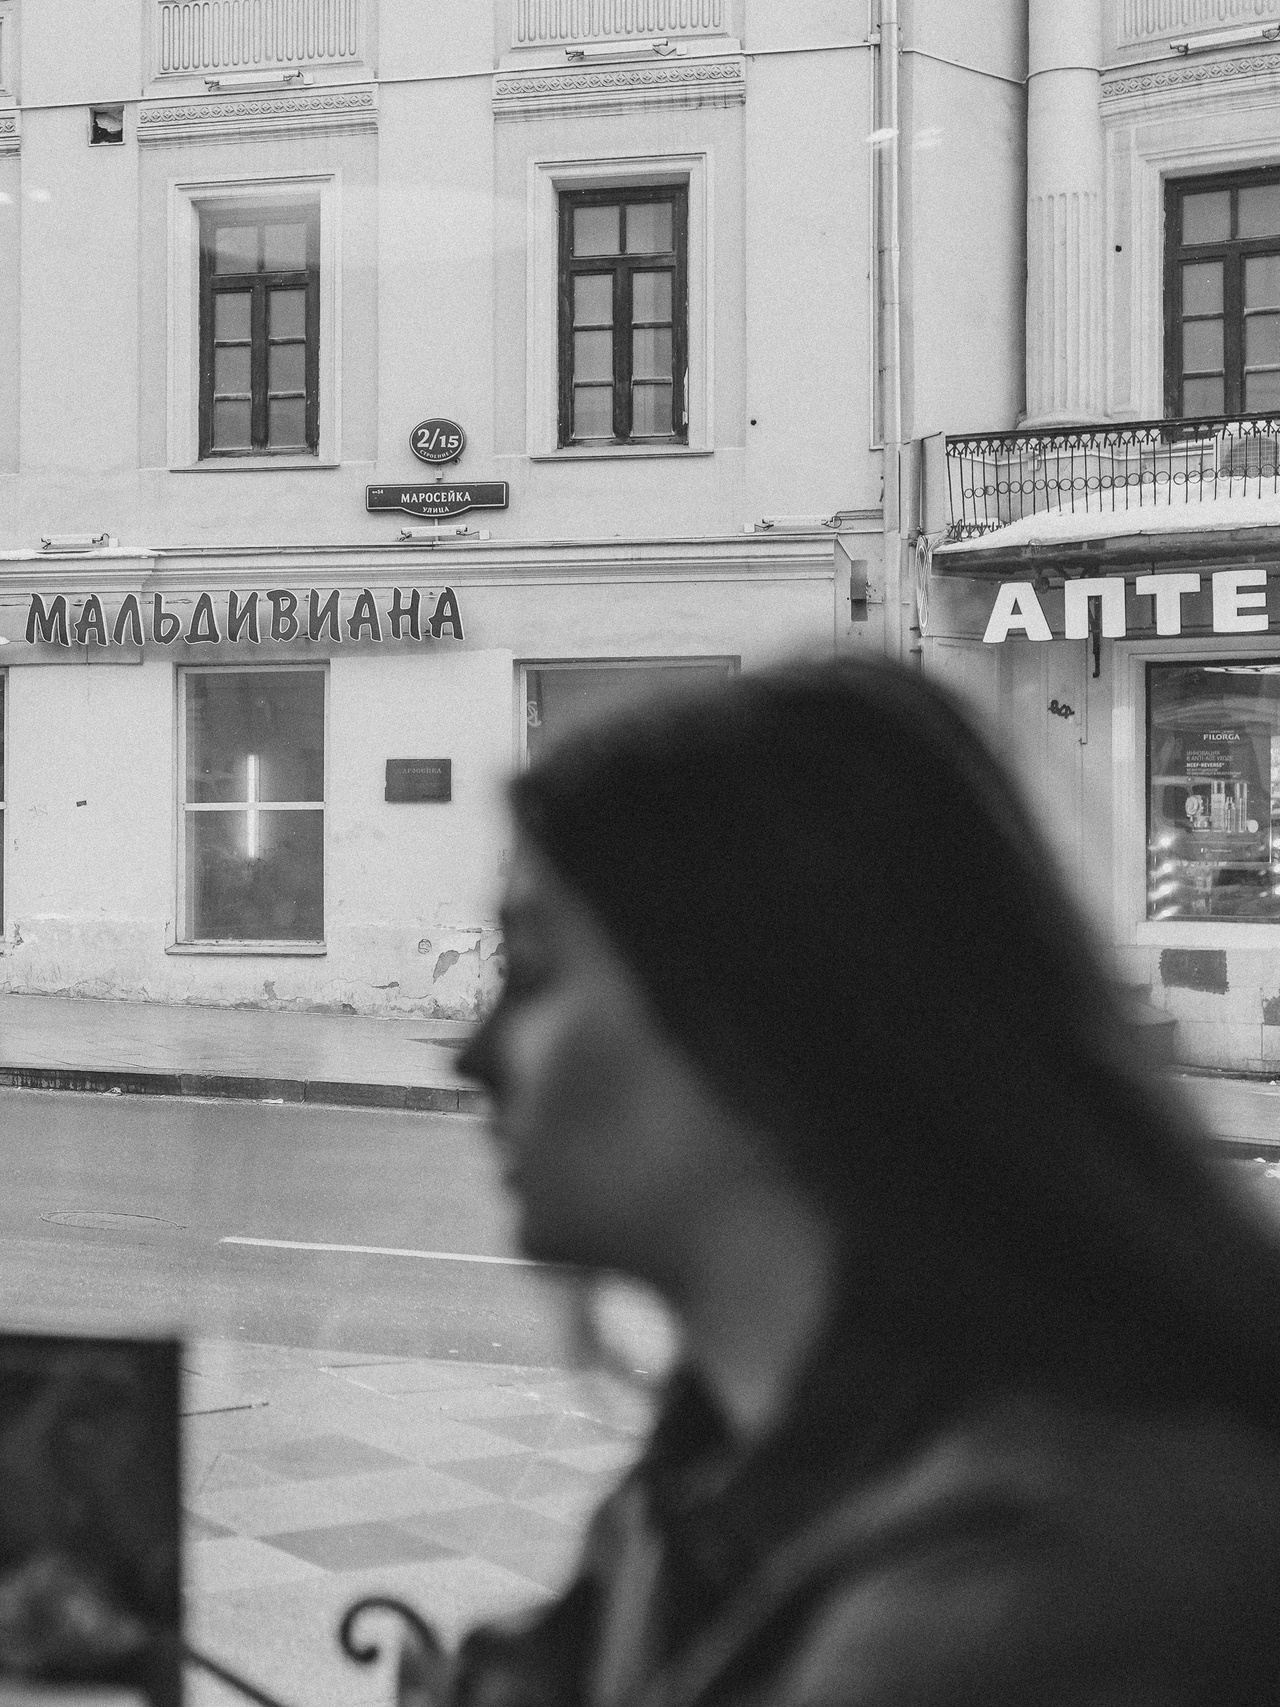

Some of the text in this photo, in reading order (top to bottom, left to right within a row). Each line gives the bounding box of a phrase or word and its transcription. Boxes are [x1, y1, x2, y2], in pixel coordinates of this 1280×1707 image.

[417, 428, 459, 450] 2/15
[420, 449, 449, 459] СТРОЕНИЕ
[400, 490, 471, 503] МАРОСЕЙКА
[422, 506, 450, 514] УЛИЦА
[982, 569, 1269, 643] АПТЕ
[25, 586, 465, 647] МАЛЬДИВИАНА
